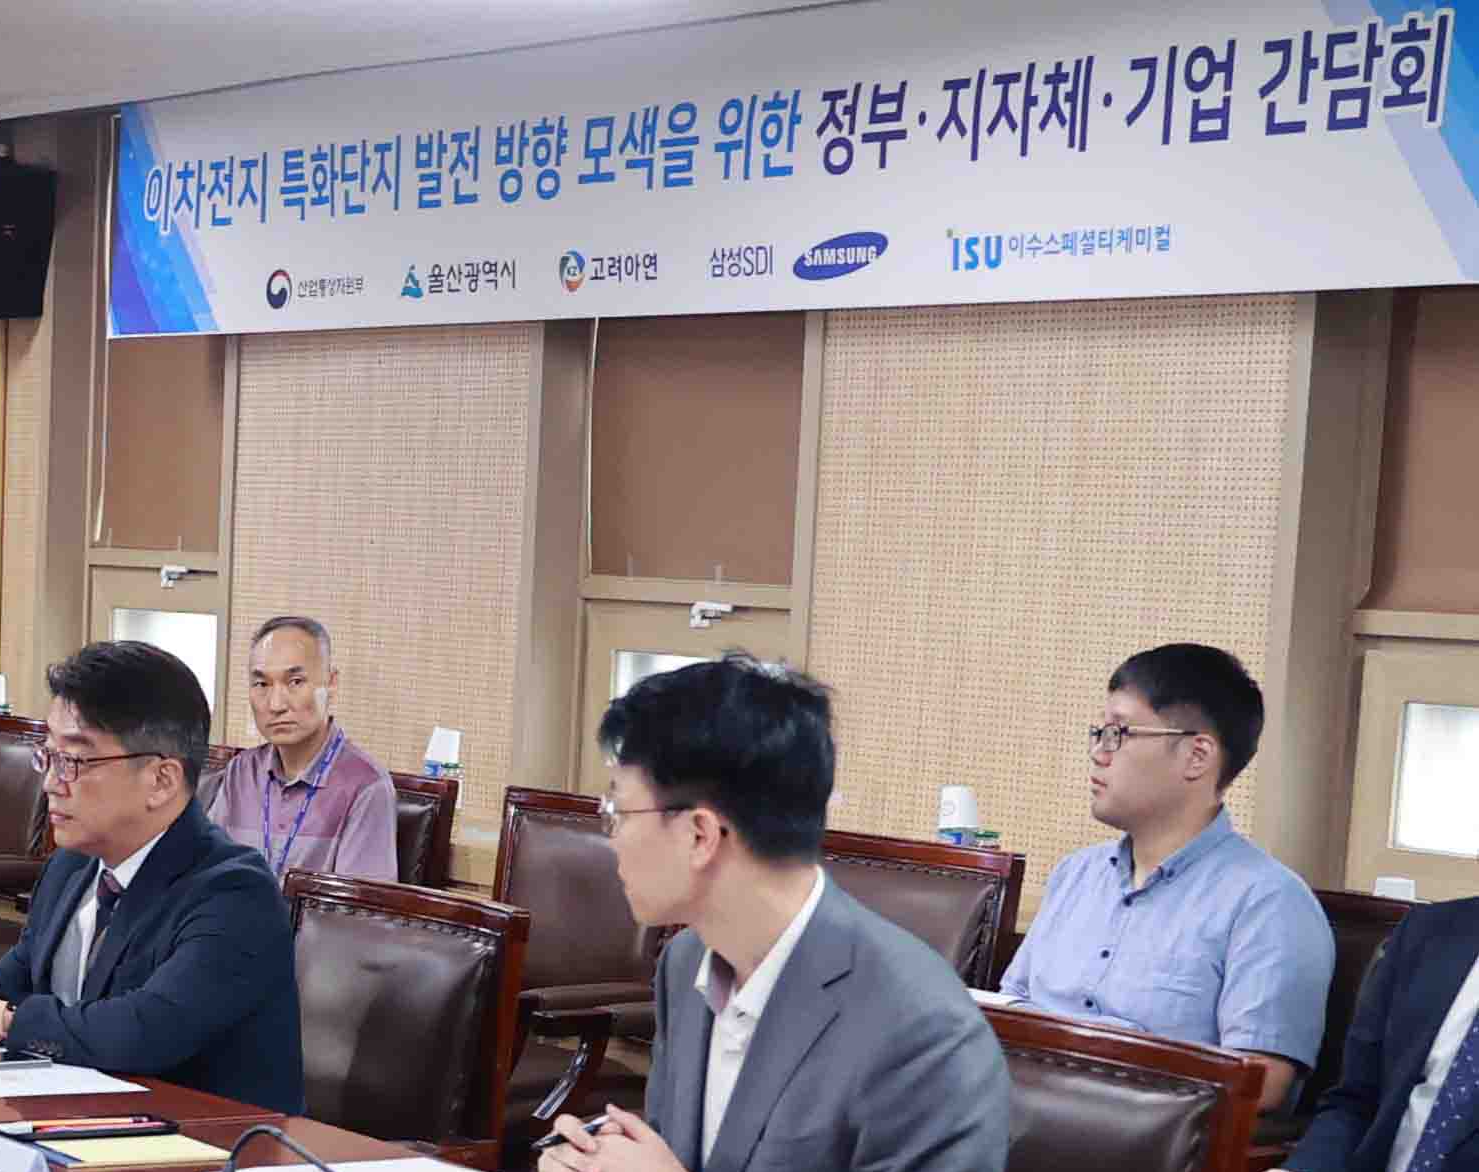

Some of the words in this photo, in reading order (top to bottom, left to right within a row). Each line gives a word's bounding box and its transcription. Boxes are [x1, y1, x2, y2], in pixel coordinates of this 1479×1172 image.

[144, 150, 269, 234] 이차전지
[279, 135, 401, 221] 특화단지
[414, 125, 481, 210] 발전
[495, 115, 568, 203] 방향
[578, 101, 701, 190] 모색을
[713, 88, 802, 181] 위한
[1257, 14, 1451, 136] 간담회
[803, 245, 878, 267] SAMSUNG
[1008, 223, 1171, 259] 이수스페셜티케미컬
[427, 256, 517, 294] 울산광역시
[589, 251, 658, 283] 고려아연
[709, 245, 774, 279] 삼성SDI
[296, 273, 365, 299] 산업통상자원부
